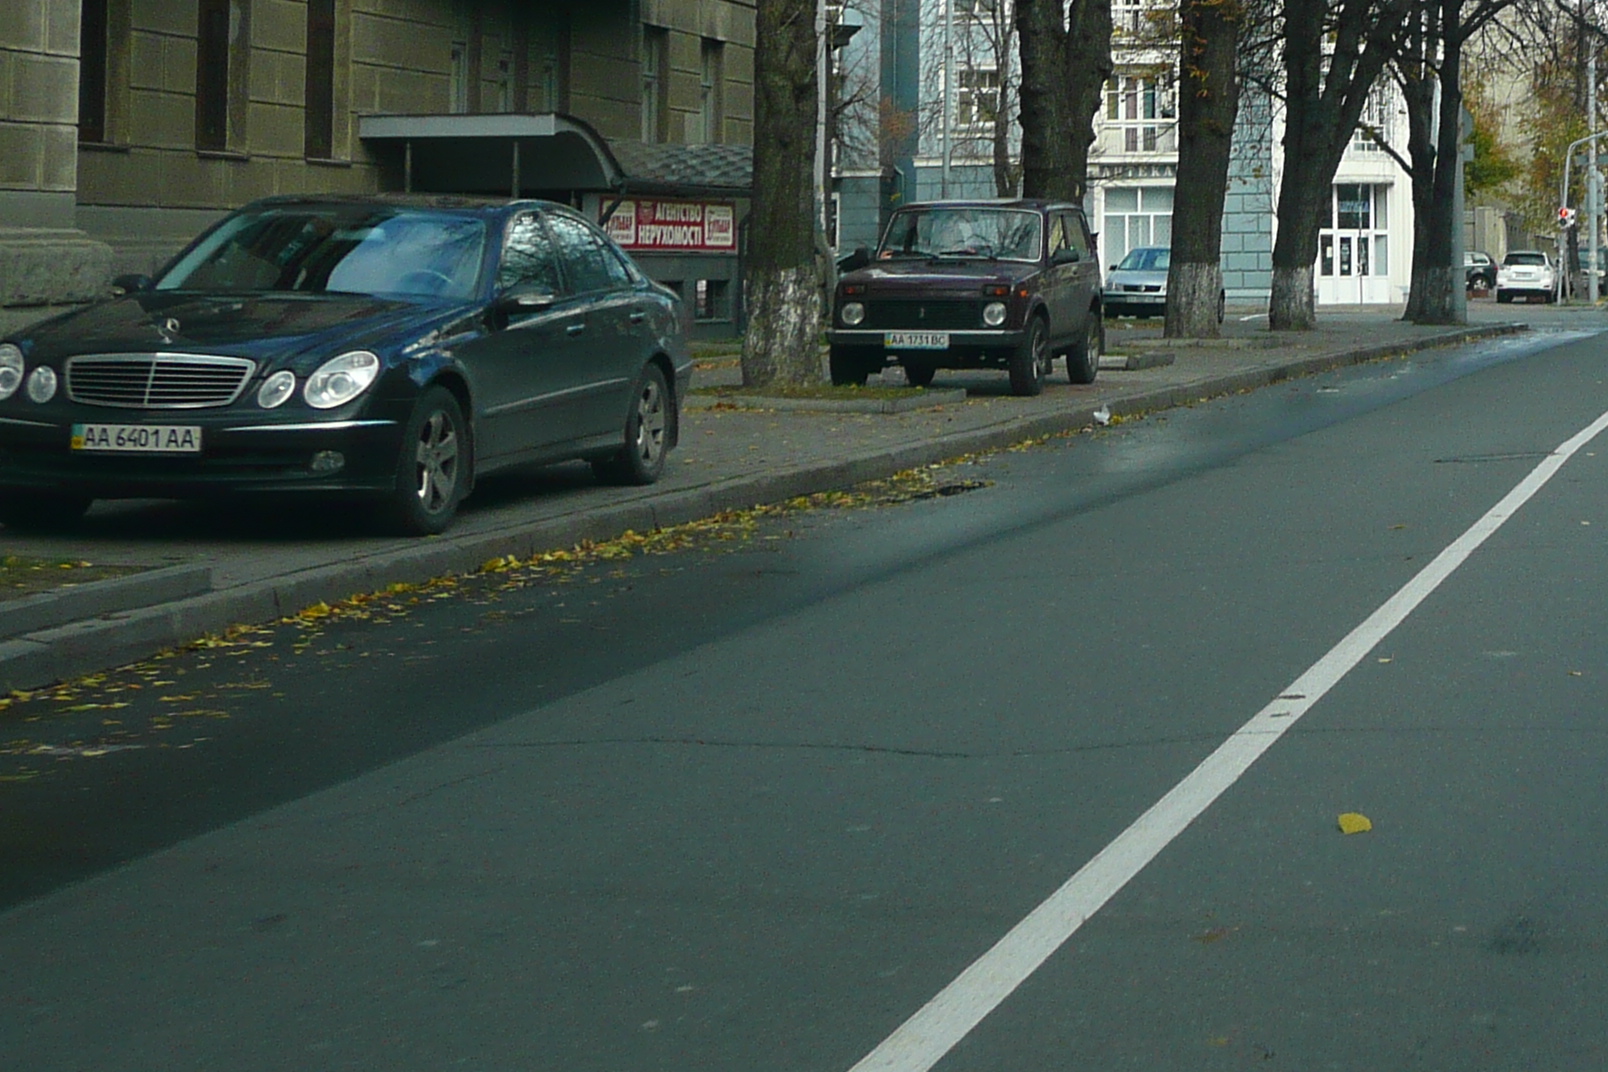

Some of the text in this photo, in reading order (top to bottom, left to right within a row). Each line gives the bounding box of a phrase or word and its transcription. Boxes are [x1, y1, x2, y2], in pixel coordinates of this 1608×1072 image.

[1102, 166, 1173, 178] АПТЕКА
[655, 202, 702, 222] АГЕНТСТВО
[638, 224, 702, 245] НЕРУХОМОСТІ
[891, 334, 904, 345] AA
[84, 427, 194, 448] AA 6401 AA
